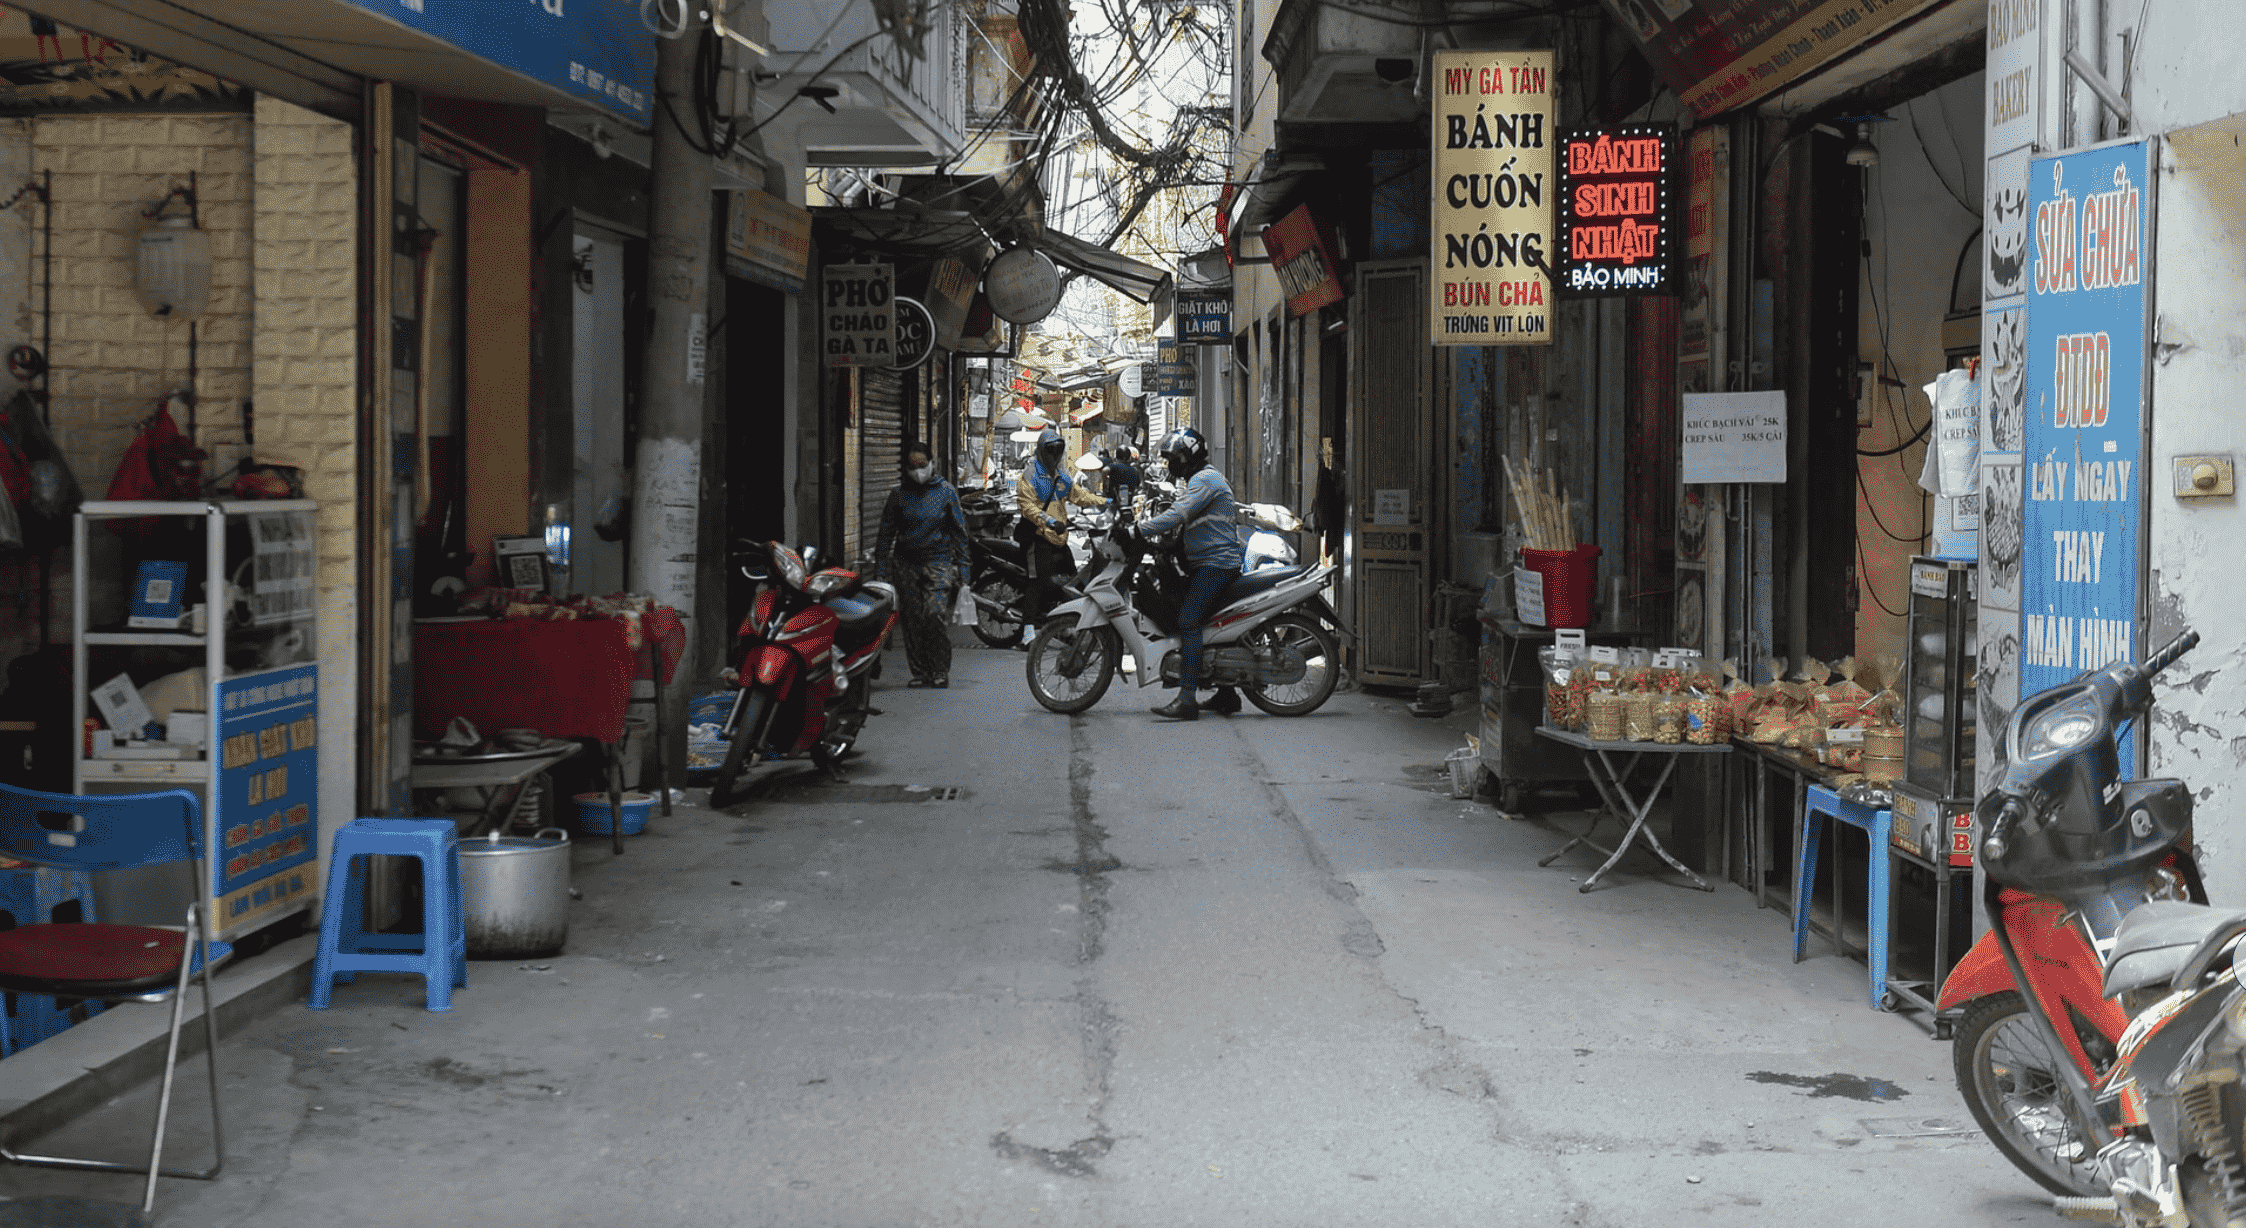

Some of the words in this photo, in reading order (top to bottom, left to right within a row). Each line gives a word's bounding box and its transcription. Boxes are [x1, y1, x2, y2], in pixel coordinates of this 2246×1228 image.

[1810, 16, 1839, 43] Thanh
[1445, 61, 1472, 95] MỲ
[1480, 61, 1503, 95] GÀ
[1993, 64, 2032, 127] BAKERY
[1446, 103, 1545, 149] BÁNH
[1570, 135, 1660, 174] BÁNH
[1446, 156, 1544, 209] CUỐN
[1575, 182, 1654, 217] SINH
[1572, 218, 1659, 264] NHẬT
[2034, 159, 2077, 296] SỬA
[2081, 161, 2140, 292] CHỮA
[1445, 222, 1544, 269] NÓNG
[825, 267, 889, 307] PHỞ
[1444, 276, 1490, 307] BÚN
[1499, 272, 1543, 307] CHẢ
[1572, 262, 1610, 287] BẢO
[1613, 266, 1659, 285] MINH
[829, 311, 887, 332] CHÁO
[1178, 299, 1203, 317] GIẶT
[1205, 298, 1228, 315] KHÔ
[1444, 311, 1488, 333] TRỨNG
[1493, 315, 1513, 337] VỊT
[1518, 311, 1544, 337] LỘN
[1186, 318, 1200, 333] LÀ
[1203, 319, 1221, 333] HƠI
[827, 334, 856, 355] GÀ
[862, 338, 890, 354] TA
[1685, 434, 1706, 444] CREP
[1713, 418, 1737, 430] BẠCH
[1763, 416, 1779, 426] 25K
[1944, 427, 1966, 440] CREP
[2032, 446, 2069, 501] LẤY
[2054, 531, 2105, 584] THAY
[2027, 604, 2073, 668] MÀN
[2079, 606, 2131, 671] HÌNH
